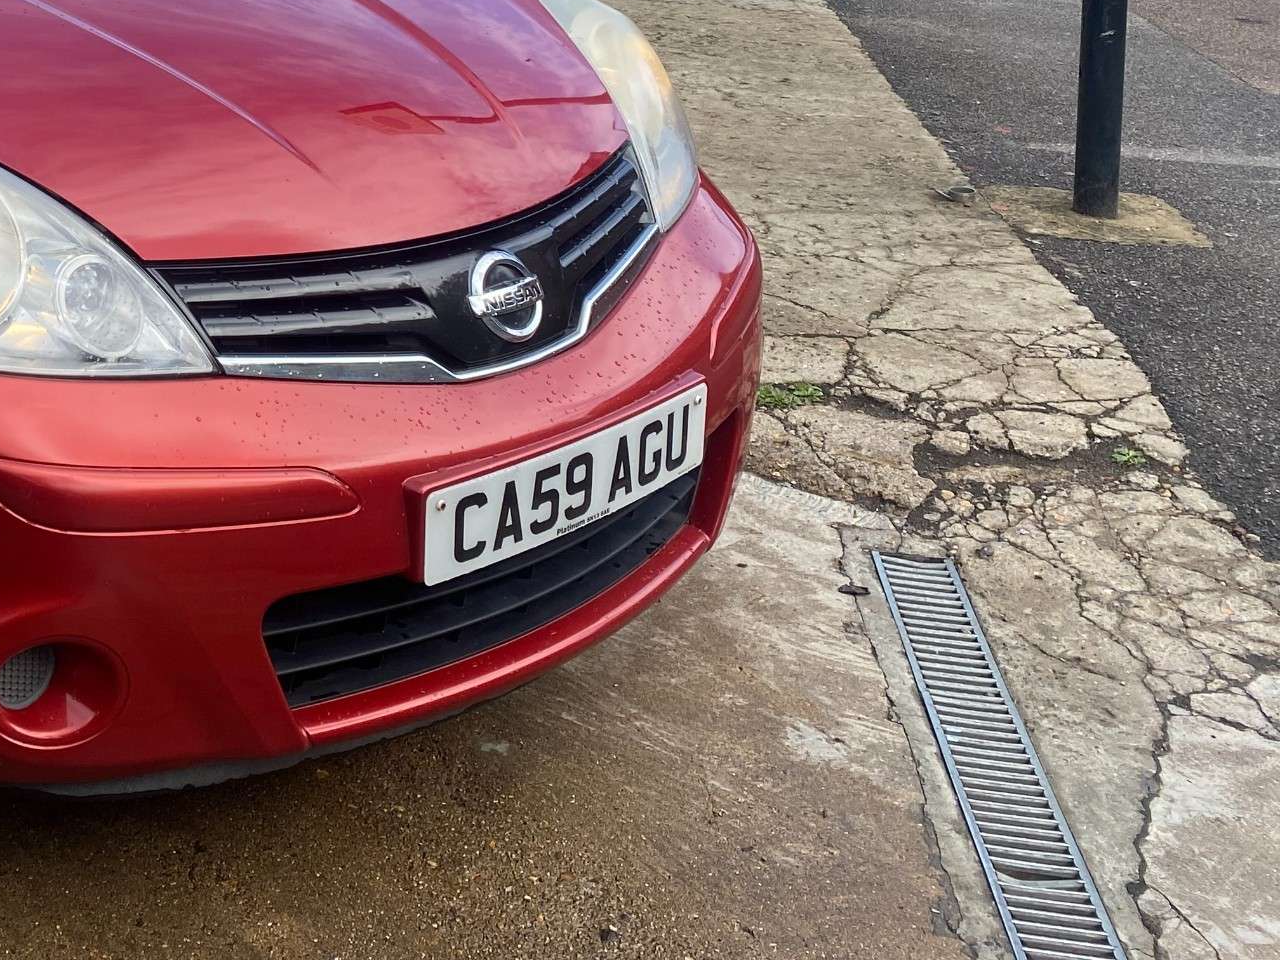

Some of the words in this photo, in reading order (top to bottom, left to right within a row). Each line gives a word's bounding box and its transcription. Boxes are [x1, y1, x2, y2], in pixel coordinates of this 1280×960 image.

[483, 280, 544, 313] NISSAN
[454, 452, 594, 563] CA59
[608, 403, 690, 503] AGU
[556, 519, 586, 536] Platinum
